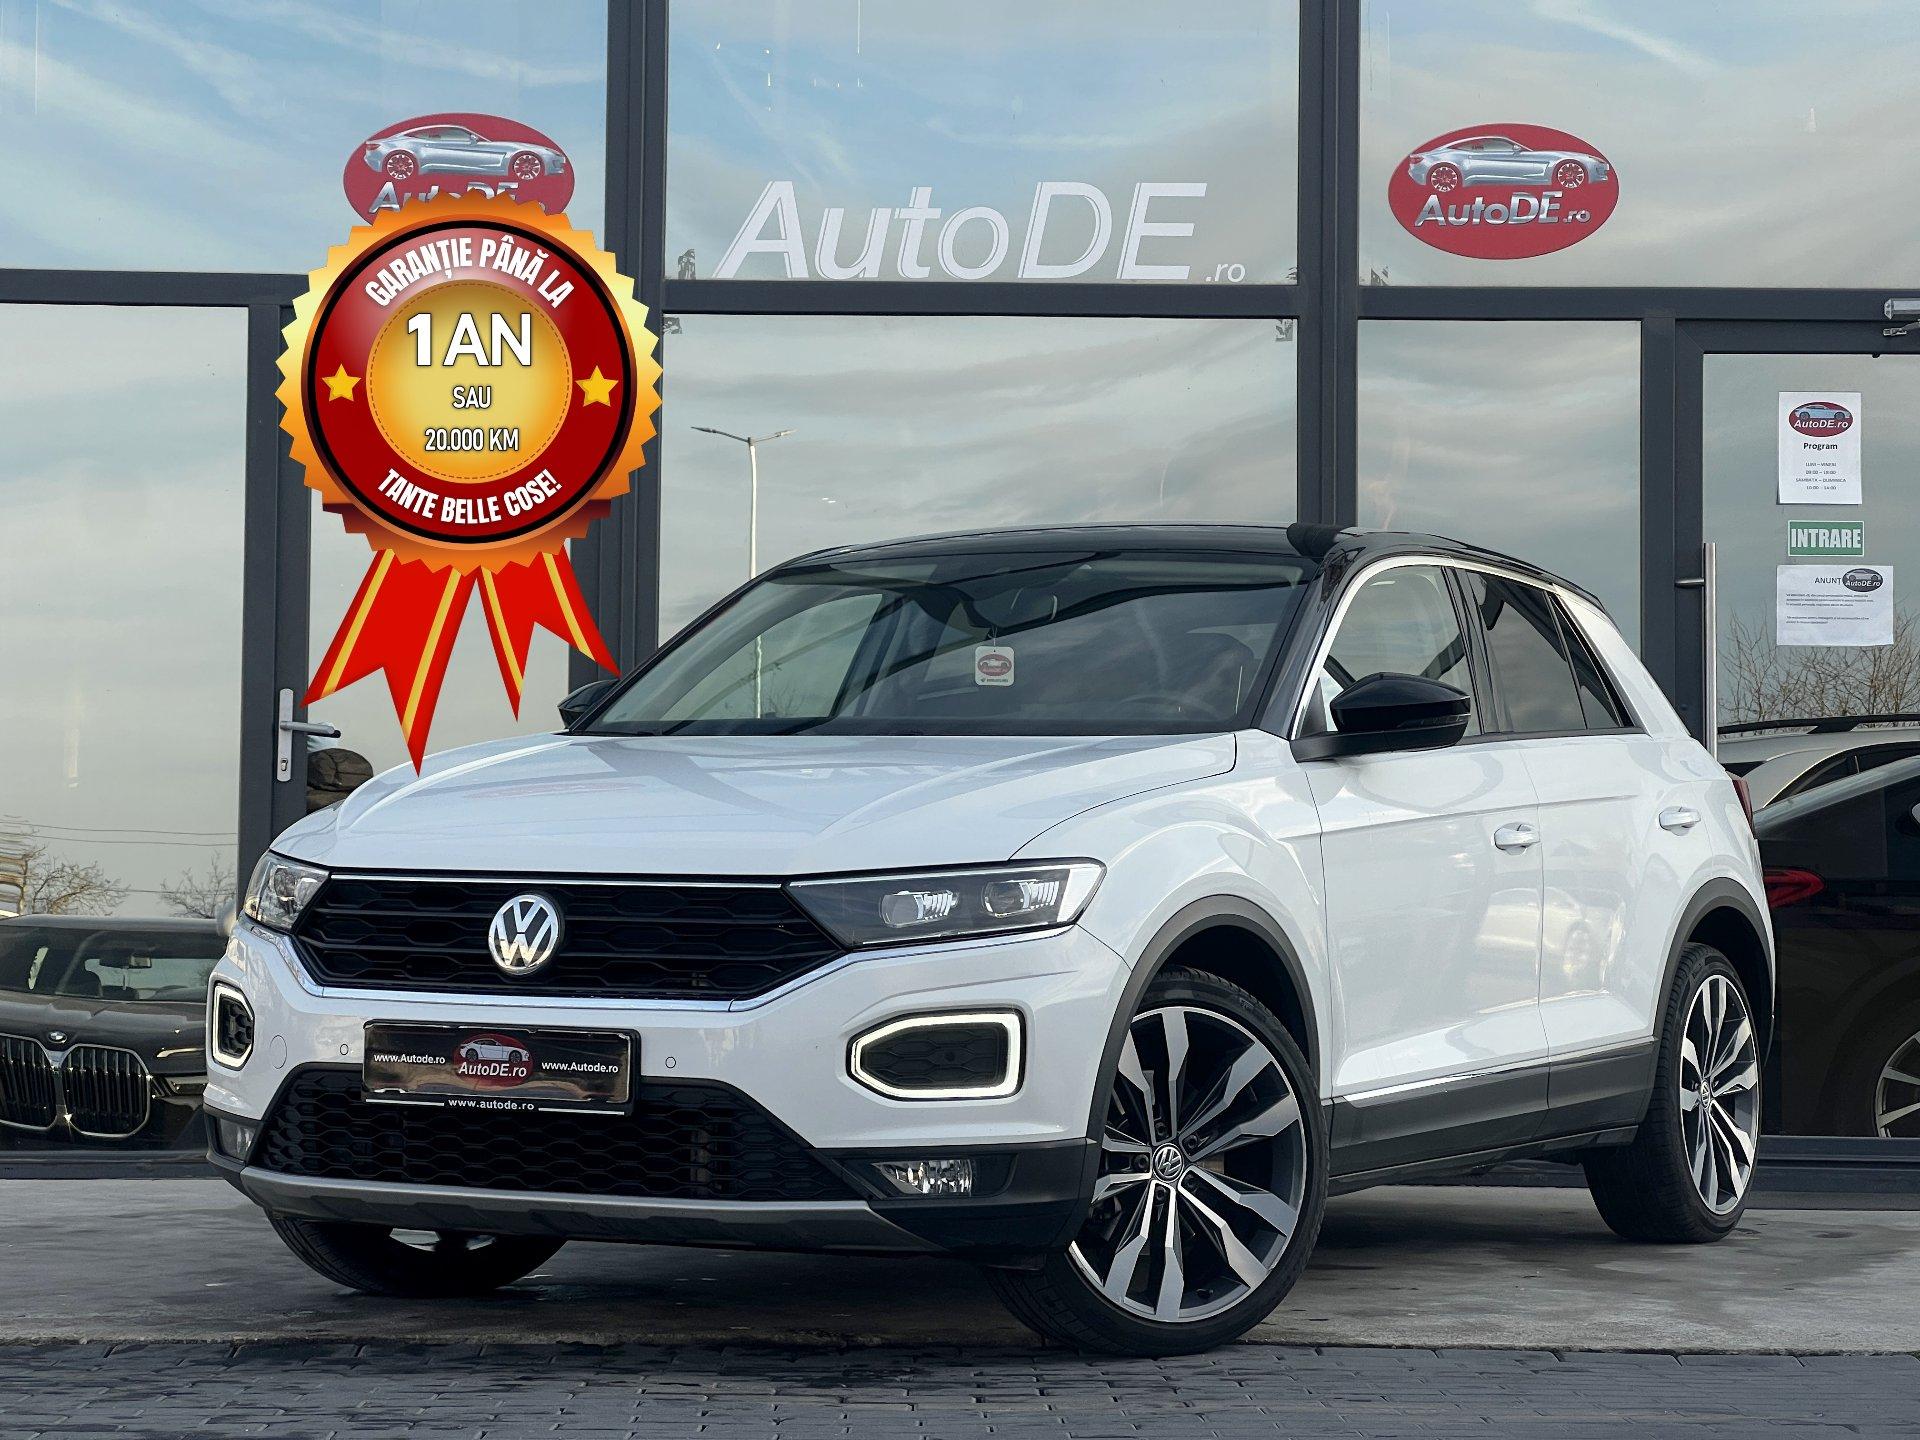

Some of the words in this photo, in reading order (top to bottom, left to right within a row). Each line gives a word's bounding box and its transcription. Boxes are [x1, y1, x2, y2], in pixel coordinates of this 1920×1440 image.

[1793, 419, 1849, 429] AutoDE.ro
[1803, 442, 1838, 451] Program
[1791, 528, 1862, 548] INTRARE
[373, 1053, 446, 1065] www.Autode.ro
[458, 1062, 528, 1078] AutoDE.ro
[541, 1061, 619, 1074] www.Autode.ro
[448, 1099, 535, 1111] www.autode.ro
